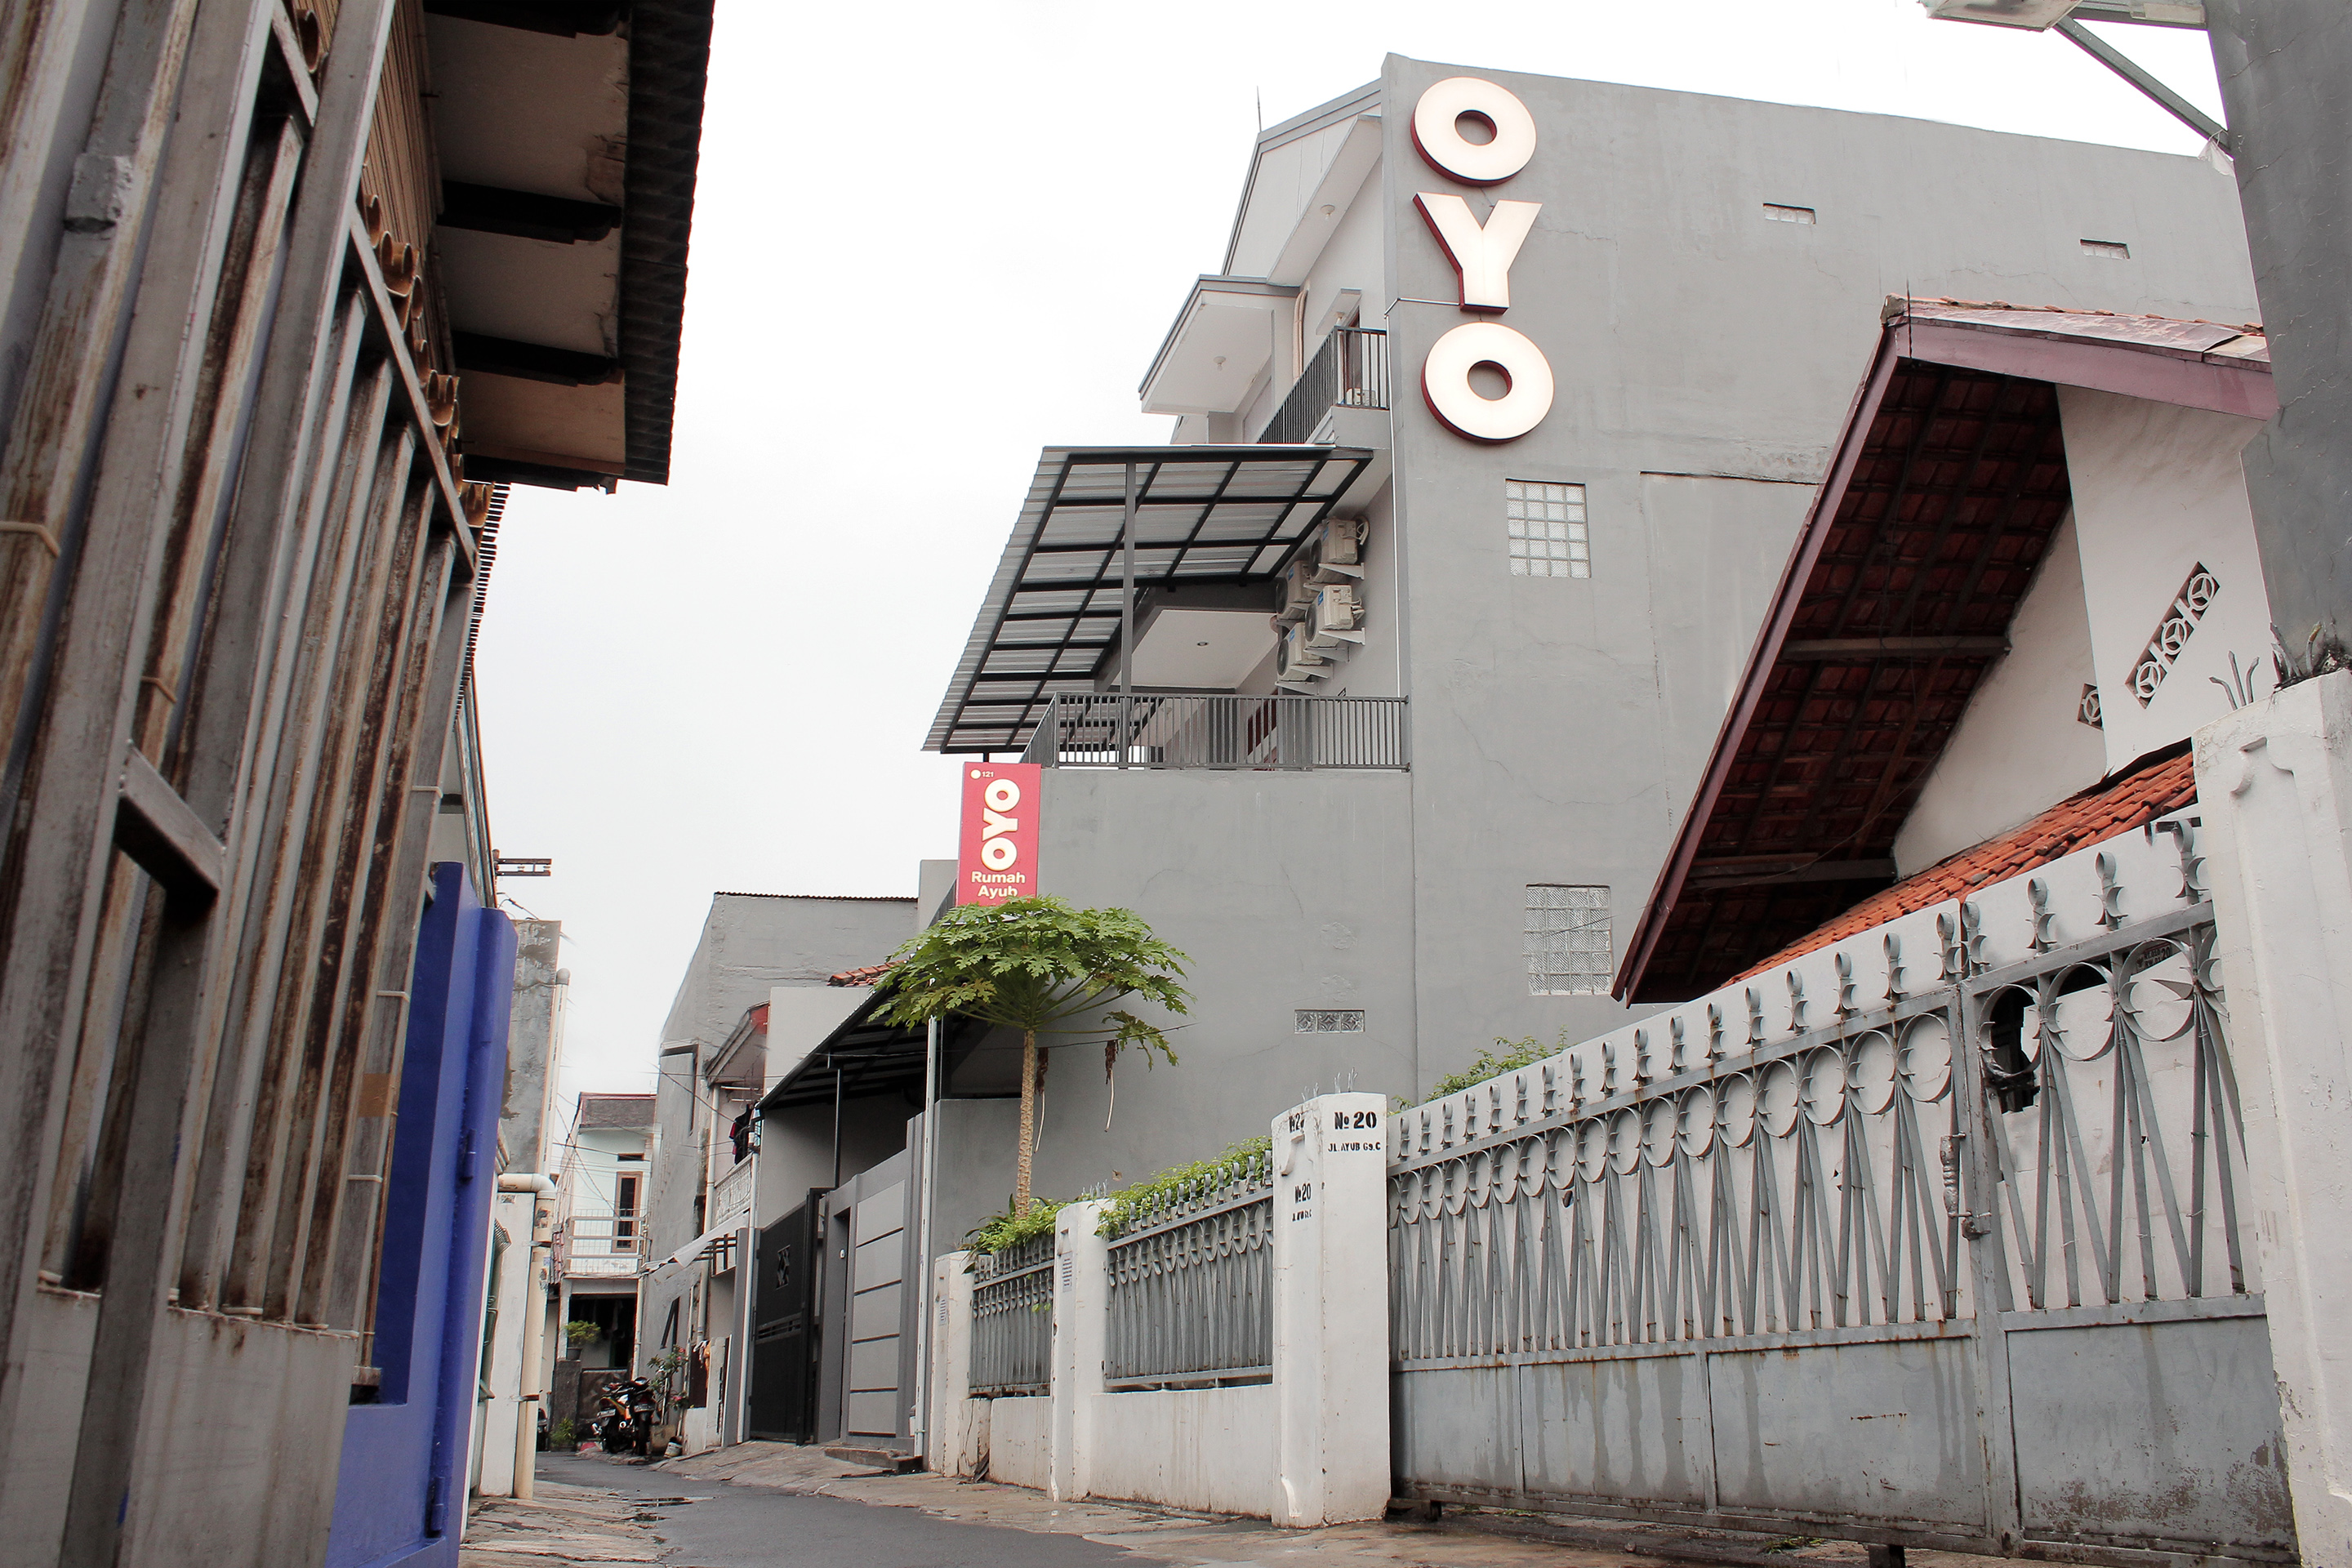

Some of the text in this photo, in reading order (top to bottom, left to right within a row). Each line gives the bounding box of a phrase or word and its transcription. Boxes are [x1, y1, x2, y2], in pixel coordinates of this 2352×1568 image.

[1410, 76, 1555, 446] OYO
[981, 778, 1021, 871] OYO
[971, 871, 1026, 884] Rumah
[978, 884, 1018, 899] Ayub
[1353, 1111, 1378, 1129] 20
[1328, 1143, 1339, 1152] JL.
[1341, 1142, 1361, 1152] AYUB
[1302, 1183, 1312, 1201] 20
